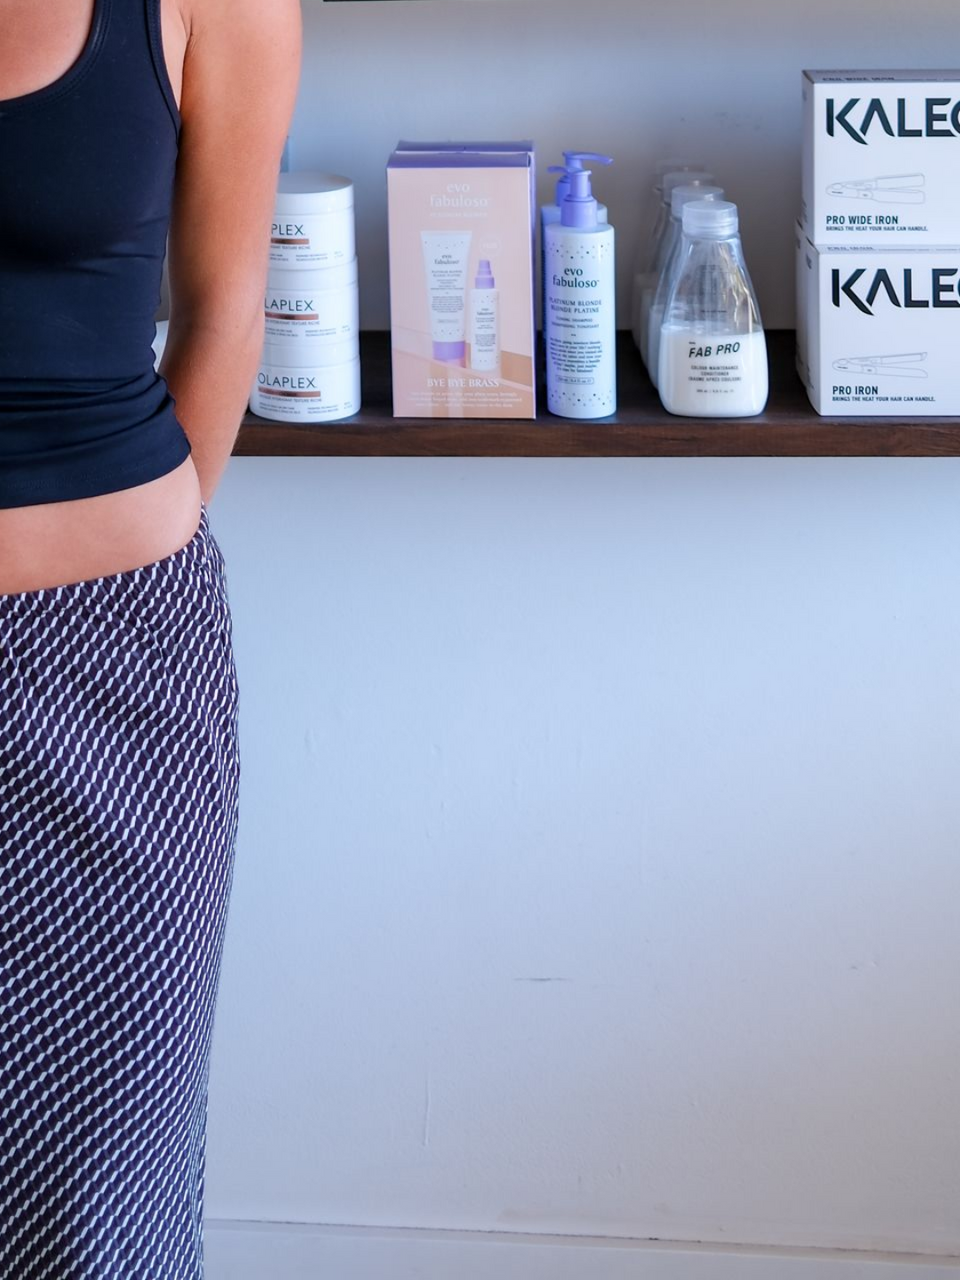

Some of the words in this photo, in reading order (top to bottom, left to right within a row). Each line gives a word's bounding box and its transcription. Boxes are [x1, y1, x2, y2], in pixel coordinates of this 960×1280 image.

[826, 216, 846, 224] PRO
[848, 216, 871, 224] WIDE
[875, 216, 898, 224] IRON
[271, 224, 306, 236] PLEX
[564, 267, 584, 276] evo
[552, 276, 598, 288] fabuloso
[832, 268, 960, 316] KALE
[264, 300, 314, 311] LAPLEX
[688, 345, 712, 358] FAB
[716, 342, 740, 355] PRO
[258, 374, 317, 389] OLAPLEX
[427, 379, 445, 388] BYE
[448, 379, 466, 388] BYE
[469, 379, 499, 388] BRASS
[832, 386, 852, 395] PRO
[855, 386, 878, 395] IRON
